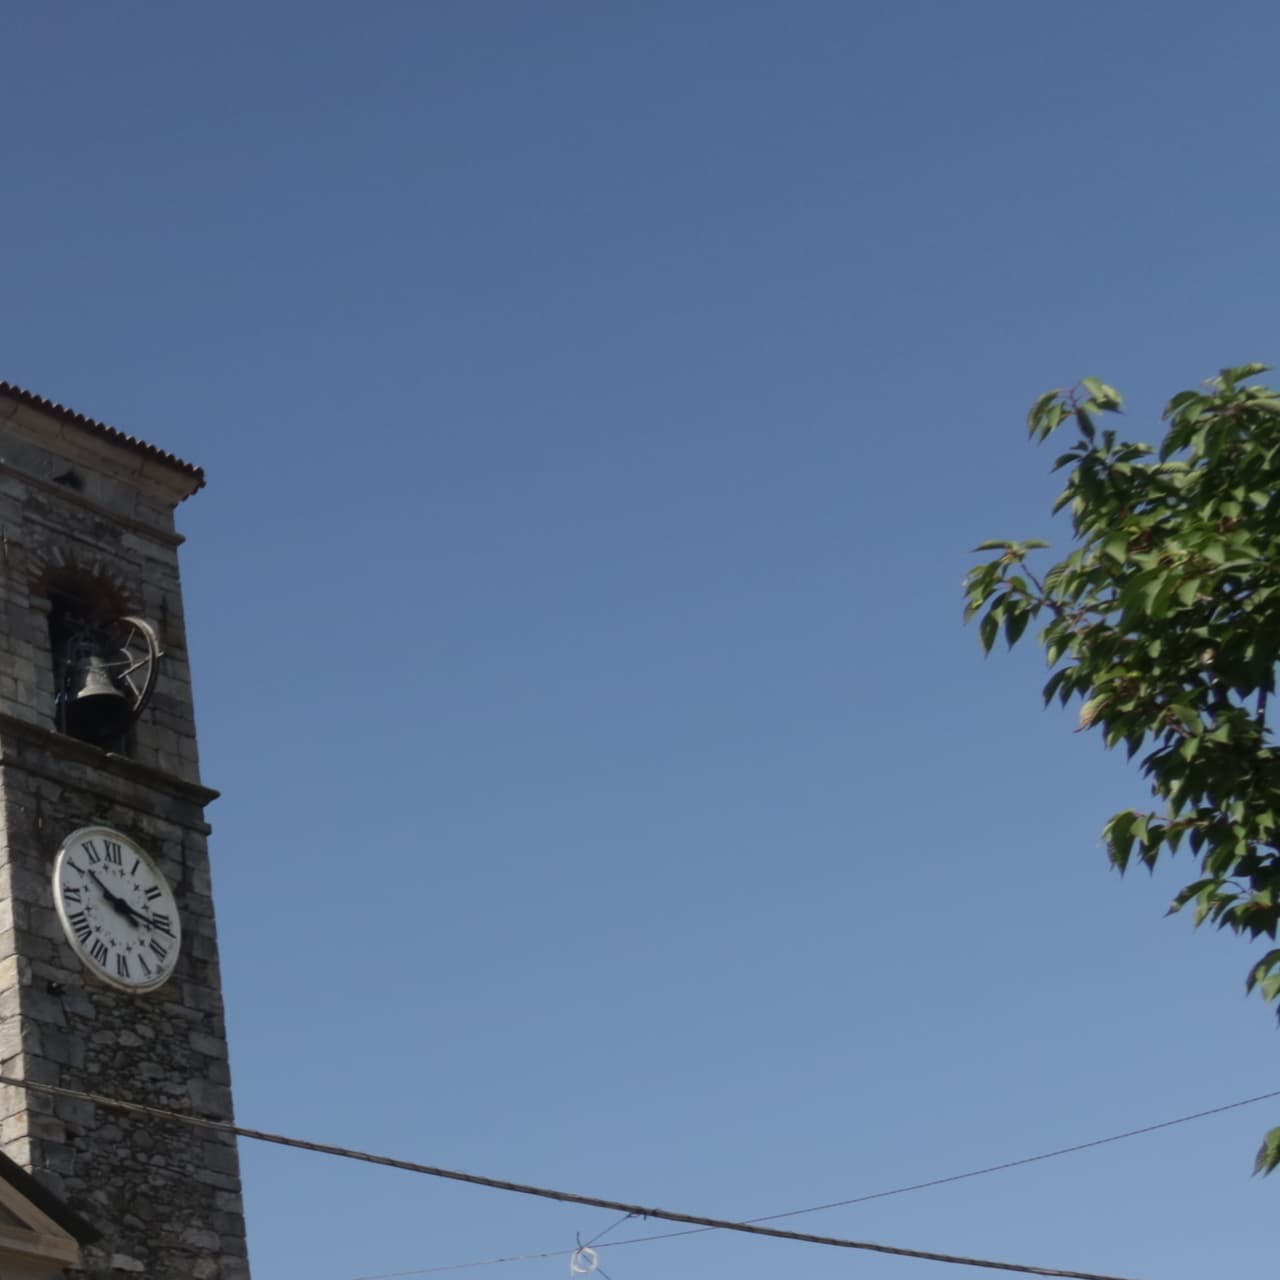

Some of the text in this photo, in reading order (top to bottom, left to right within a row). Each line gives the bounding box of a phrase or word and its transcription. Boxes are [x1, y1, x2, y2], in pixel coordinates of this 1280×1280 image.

[81, 840, 101, 864] XI
[103, 839, 122, 866] XII
[144, 885, 162, 901] II
[69, 911, 93, 945] VIII
[116, 953, 131, 978] VI
